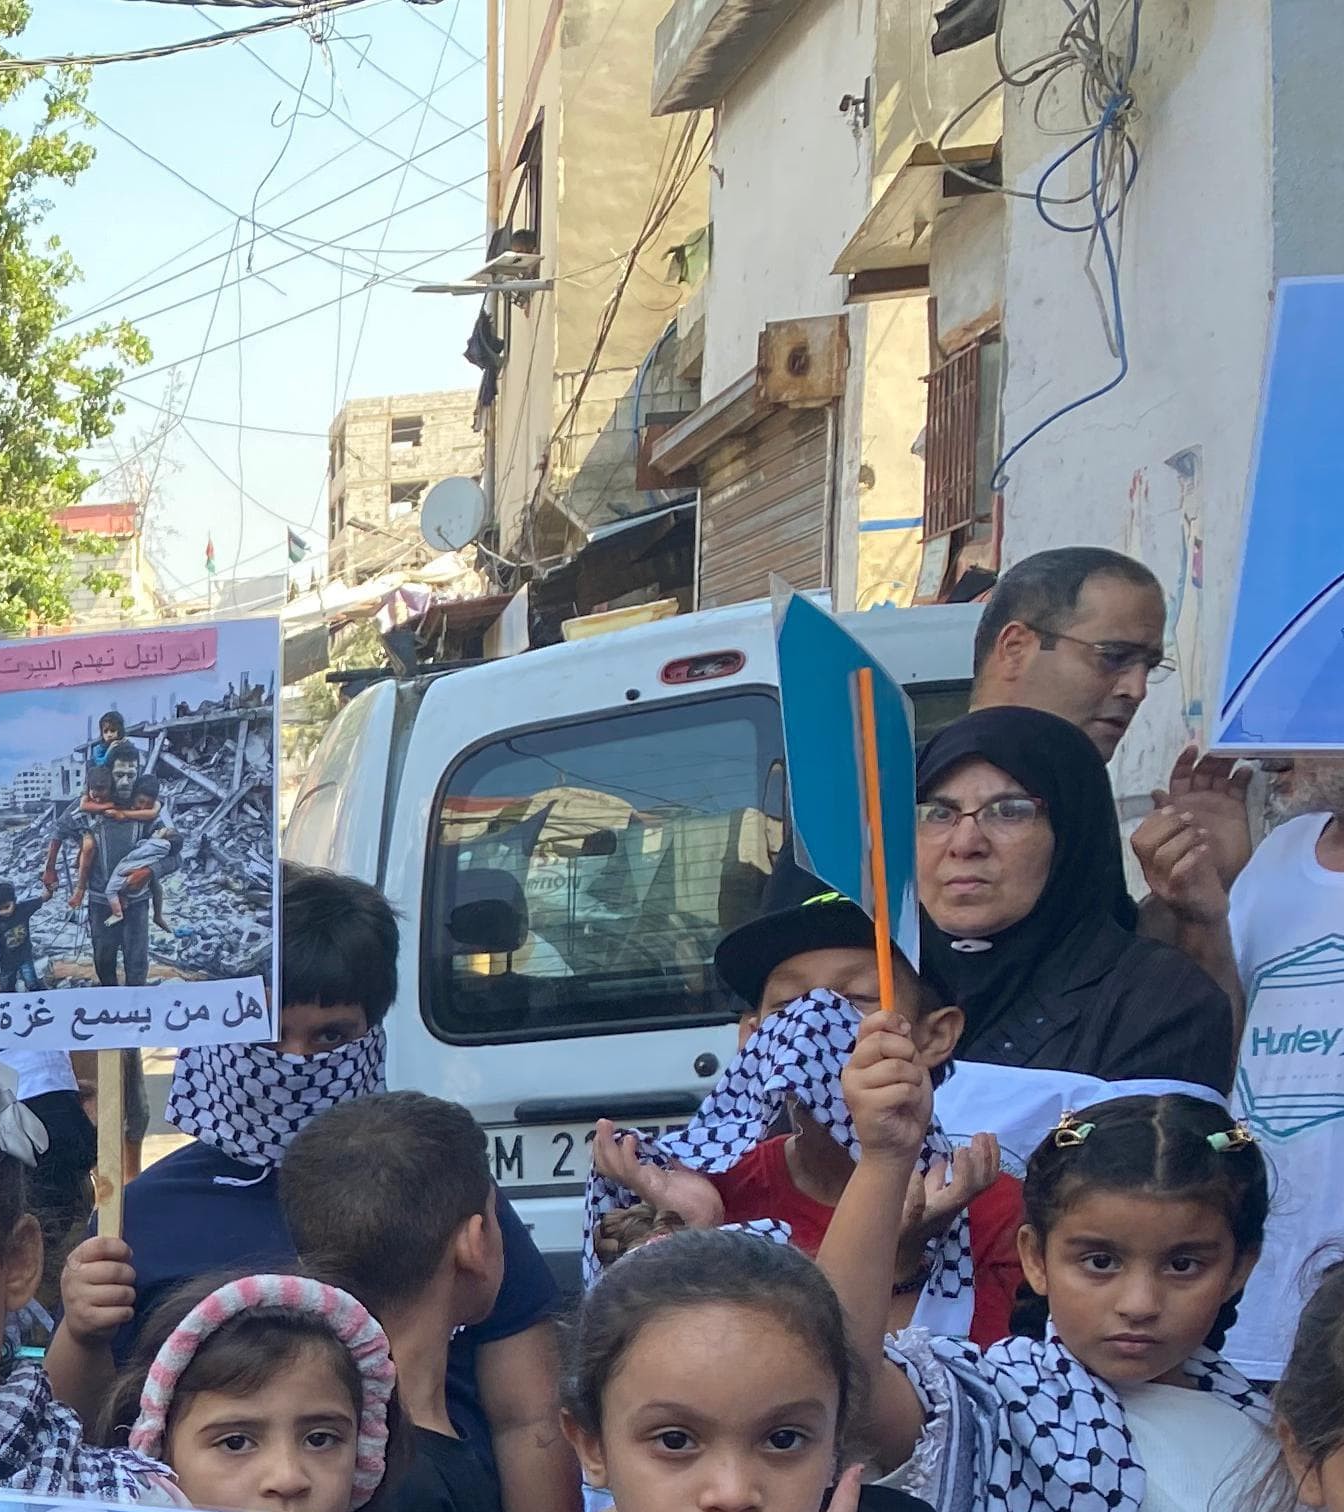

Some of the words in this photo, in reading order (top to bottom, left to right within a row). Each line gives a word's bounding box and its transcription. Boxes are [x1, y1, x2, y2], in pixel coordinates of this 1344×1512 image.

[72, 648, 115, 680] تهدم
[71, 1005, 152, 1041] يسمع
[165, 999, 210, 1031] من
[223, 990, 263, 1028] هل
[1251, 1024, 1343, 1057] Hurley
